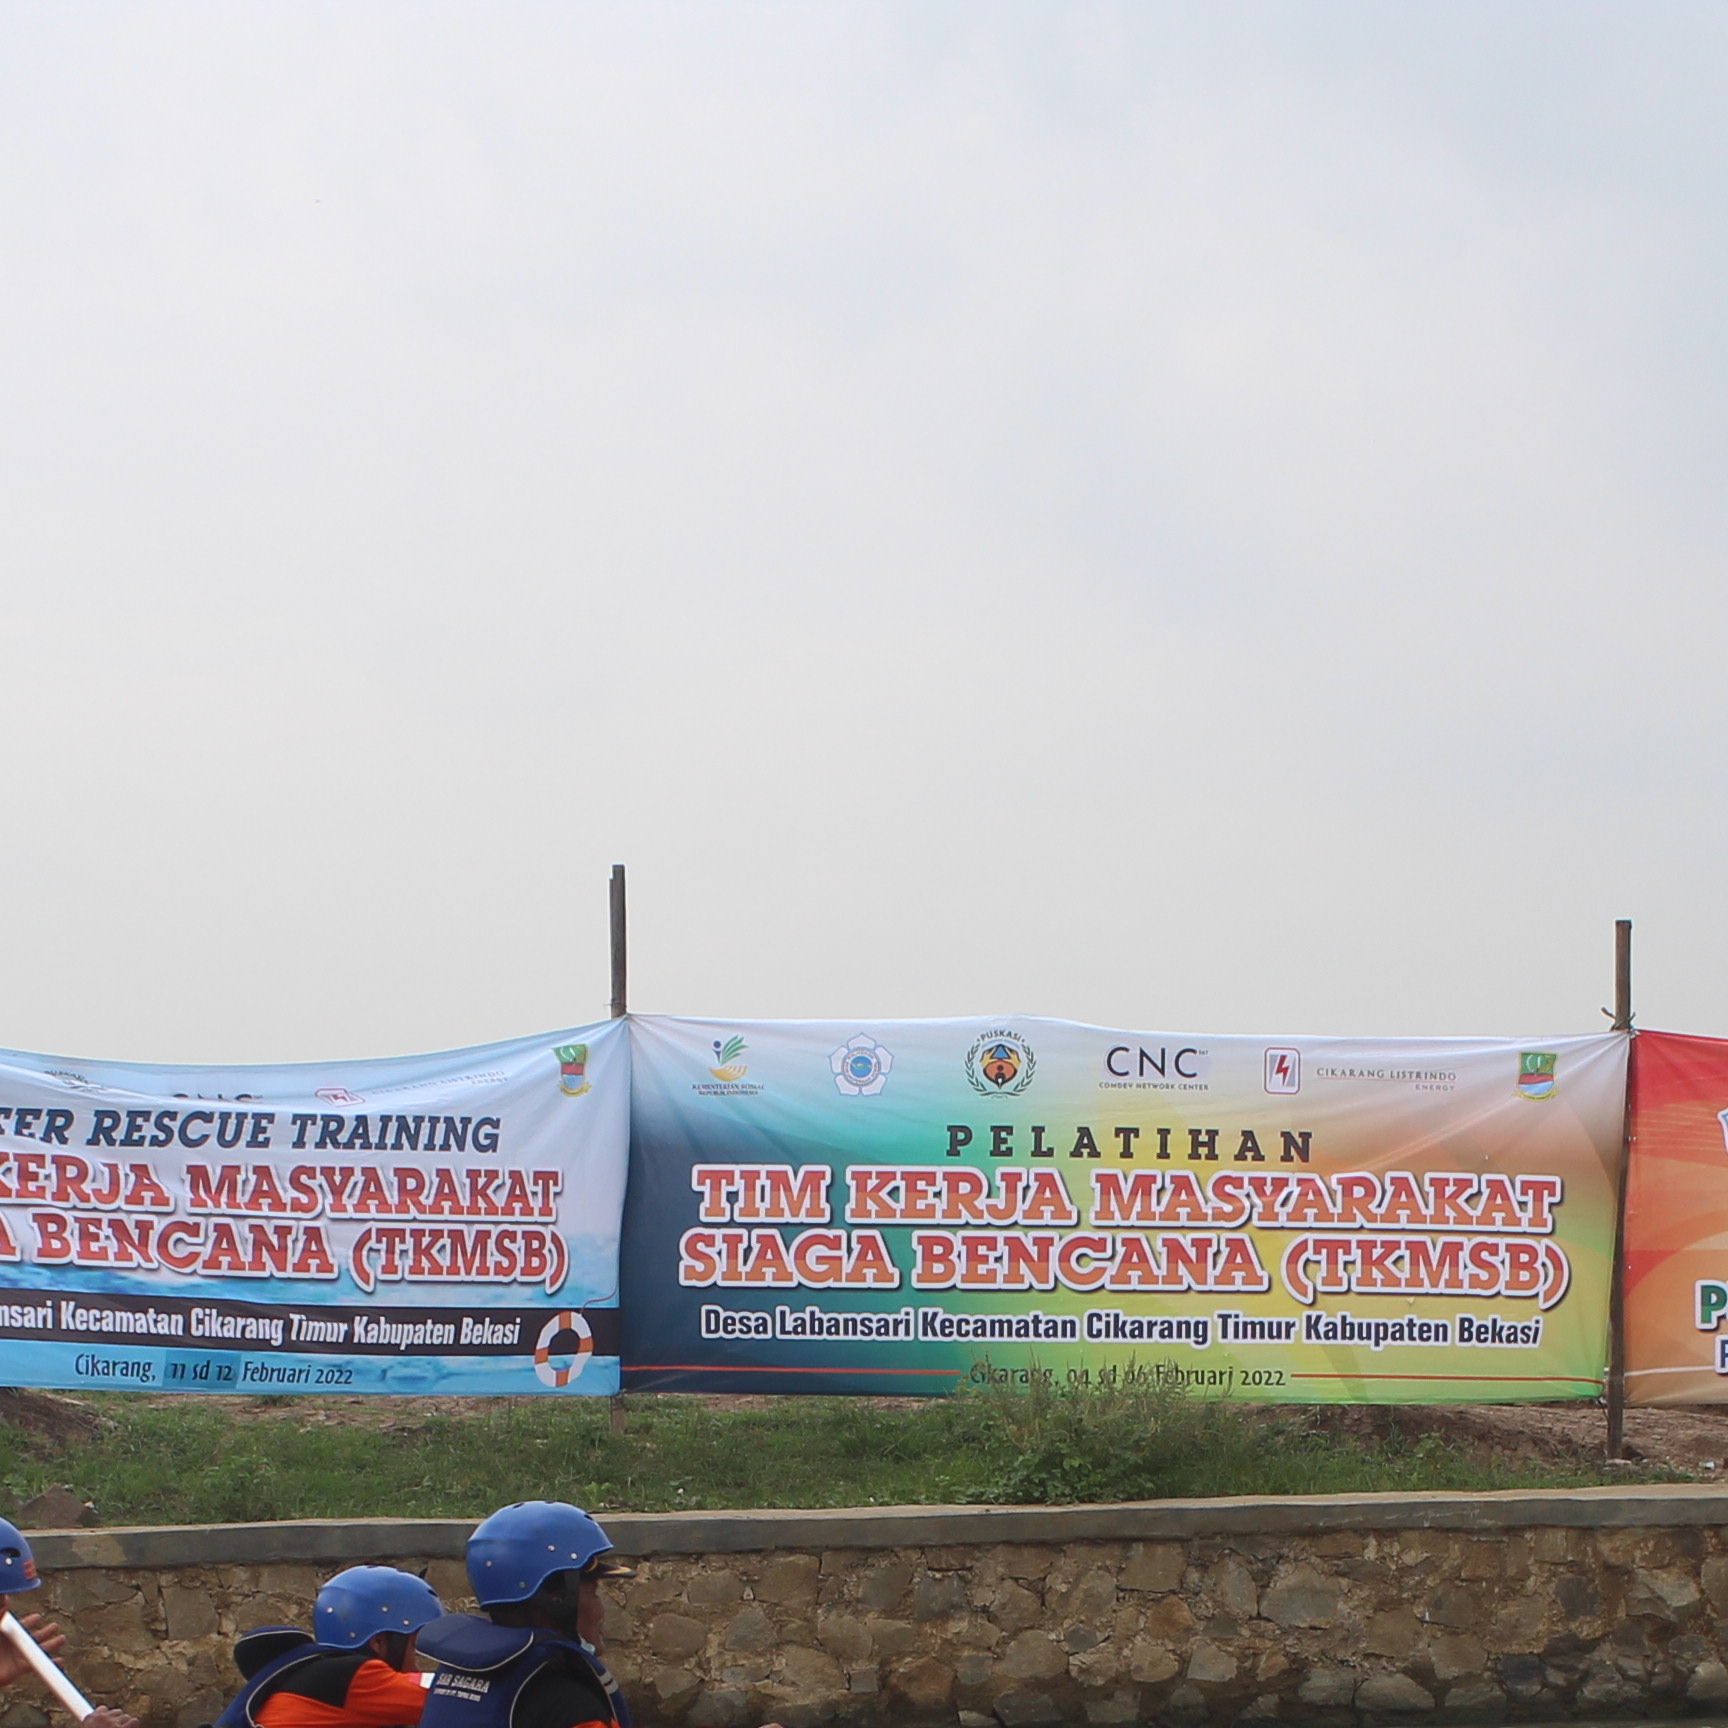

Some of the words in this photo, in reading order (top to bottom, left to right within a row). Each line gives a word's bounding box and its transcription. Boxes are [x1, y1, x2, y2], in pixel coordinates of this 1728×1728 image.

[980, 1028, 1022, 1042] PUSKASI
[1105, 1045, 1198, 1079] CNC
[1316, 1067, 1385, 1080] CIKARANG
[1389, 1070, 1457, 1082] LISTRINDO
[1099, 1082, 1134, 1090] COMDEV
[1135, 1082, 1175, 1091] NETWORK
[1177, 1083, 1209, 1092] CENTER
[1415, 1083, 1455, 1092] ENERGY
[87, 1109, 276, 1148] RESCUE
[290, 1114, 502, 1153] TRAINING
[946, 1124, 1314, 1163] PELATIHAN
[185, 1164, 560, 1218] MASYARAKAT
[696, 1169, 827, 1220] TIM
[849, 1170, 1075, 1222] KERJA
[1093, 1173, 1559, 1230] MASYARAKAT
[32, 1214, 335, 1273] BENCANA
[351, 1226, 569, 1293] (TKMSB)
[682, 1231, 896, 1284] SIAGA
[915, 1234, 1265, 1287] BENCANA
[1285, 1237, 1567, 1307] (TKMSB)
[60, 1300, 184, 1336] Kecamatan
[190, 1307, 284, 1344] Cikarang
[289, 1314, 349, 1343] Timur
[352, 1315, 457, 1350] Kabupaten
[459, 1317, 521, 1347] Bekasi
[703, 1308, 771, 1337] Desa
[778, 1308, 912, 1339] Labansari
[921, 1310, 1077, 1341] Kecamatan
[1086, 1313, 1209, 1346] Cikarang
[1217, 1313, 1297, 1342] Timur
[1304, 1315, 1450, 1348] Kabupaten
[1457, 1317, 1543, 1346] Bekasi
[74, 1353, 156, 1383] Cikarang,
[192, 1360, 211, 1381] sd
[216, 1364, 233, 1382] 12
[241, 1361, 312, 1385] Februari
[315, 1369, 354, 1386] 2022
[1240, 1369, 1286, 1387] 2022
